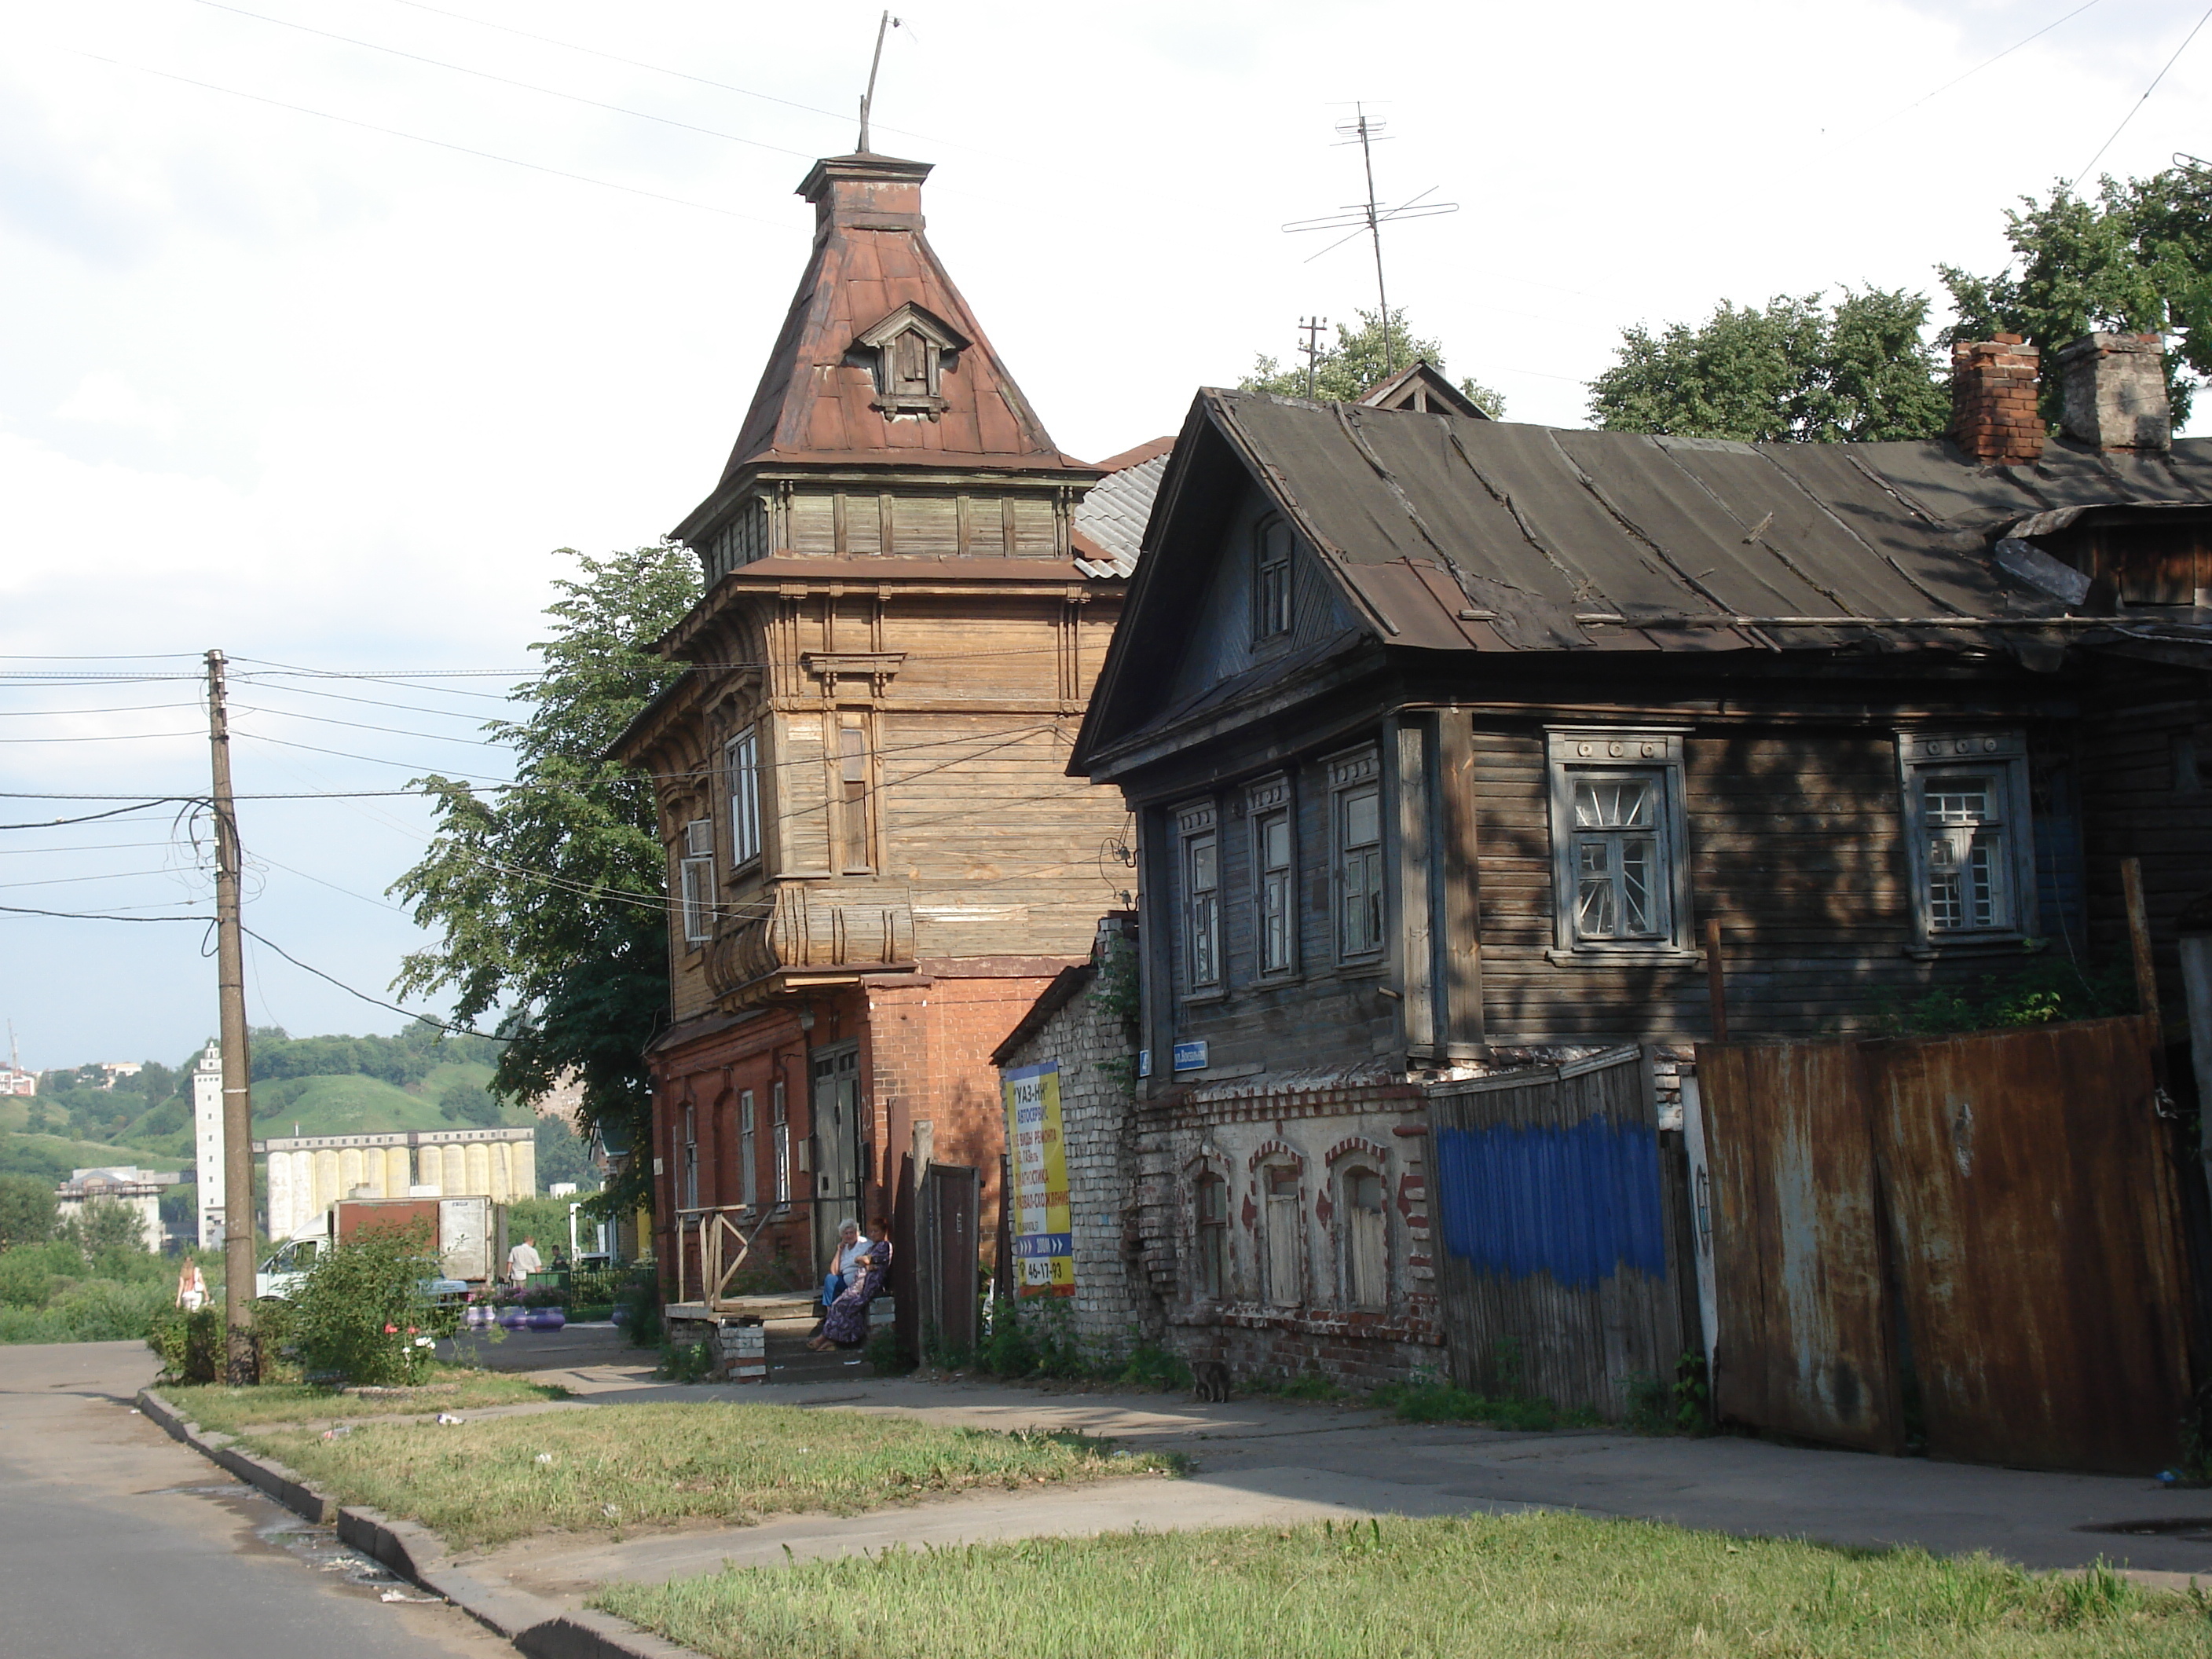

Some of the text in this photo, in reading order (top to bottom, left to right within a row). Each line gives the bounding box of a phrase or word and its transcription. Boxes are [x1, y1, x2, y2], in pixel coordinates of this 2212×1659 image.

[1017, 1105, 1048, 1123] АВТОСЕРВИС
[1020, 1131, 1033, 1147] ВИДЫ
[1035, 1129, 1057, 1144] РЕМОНТА
[1015, 1169, 1049, 1187] ДИАГНОСТИКА
[1016, 1191, 1069, 1210] РАЗВАЛ-СХОЖДЕНИЕ
[1028, 1262, 1062, 1279] 46-17-93
